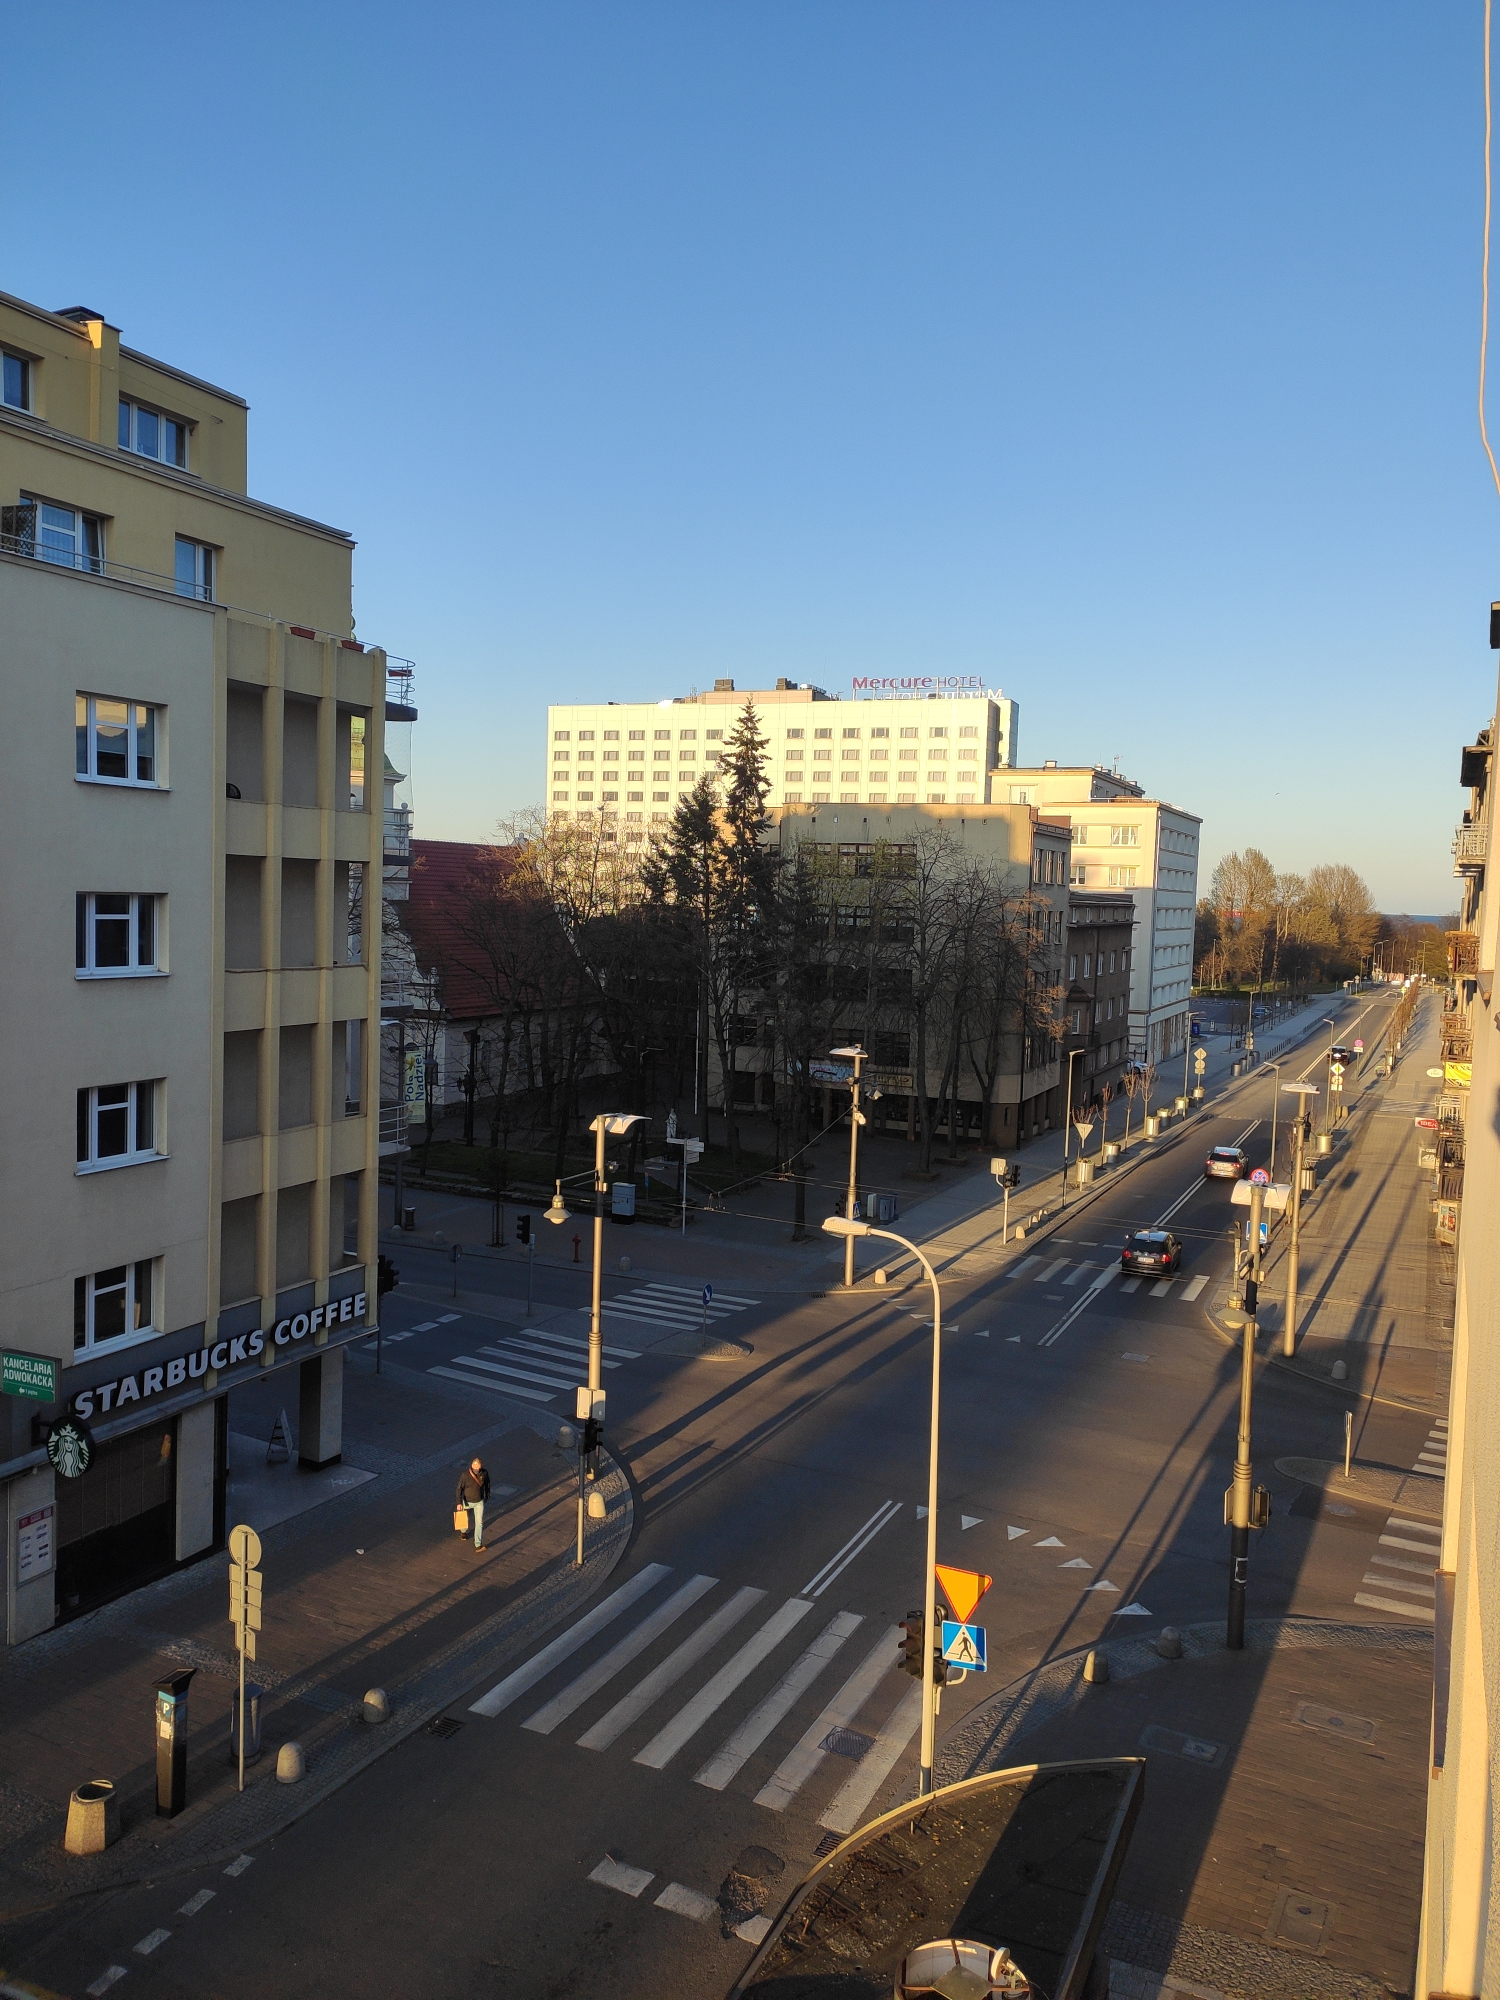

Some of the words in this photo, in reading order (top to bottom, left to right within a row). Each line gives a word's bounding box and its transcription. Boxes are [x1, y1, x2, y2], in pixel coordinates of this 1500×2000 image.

[852, 676, 932, 689] Mercure
[937, 676, 987, 687] HOTEL
[414, 1054, 424, 1101] Nadziei
[74, 1329, 264, 1420] STARBUCKS
[274, 1292, 366, 1345] COFFEE
[3, 1357, 52, 1375] KANCELARIA
[3, 1368, 53, 1388] ADWOKACKA
[163, 1702, 170, 1715] P
